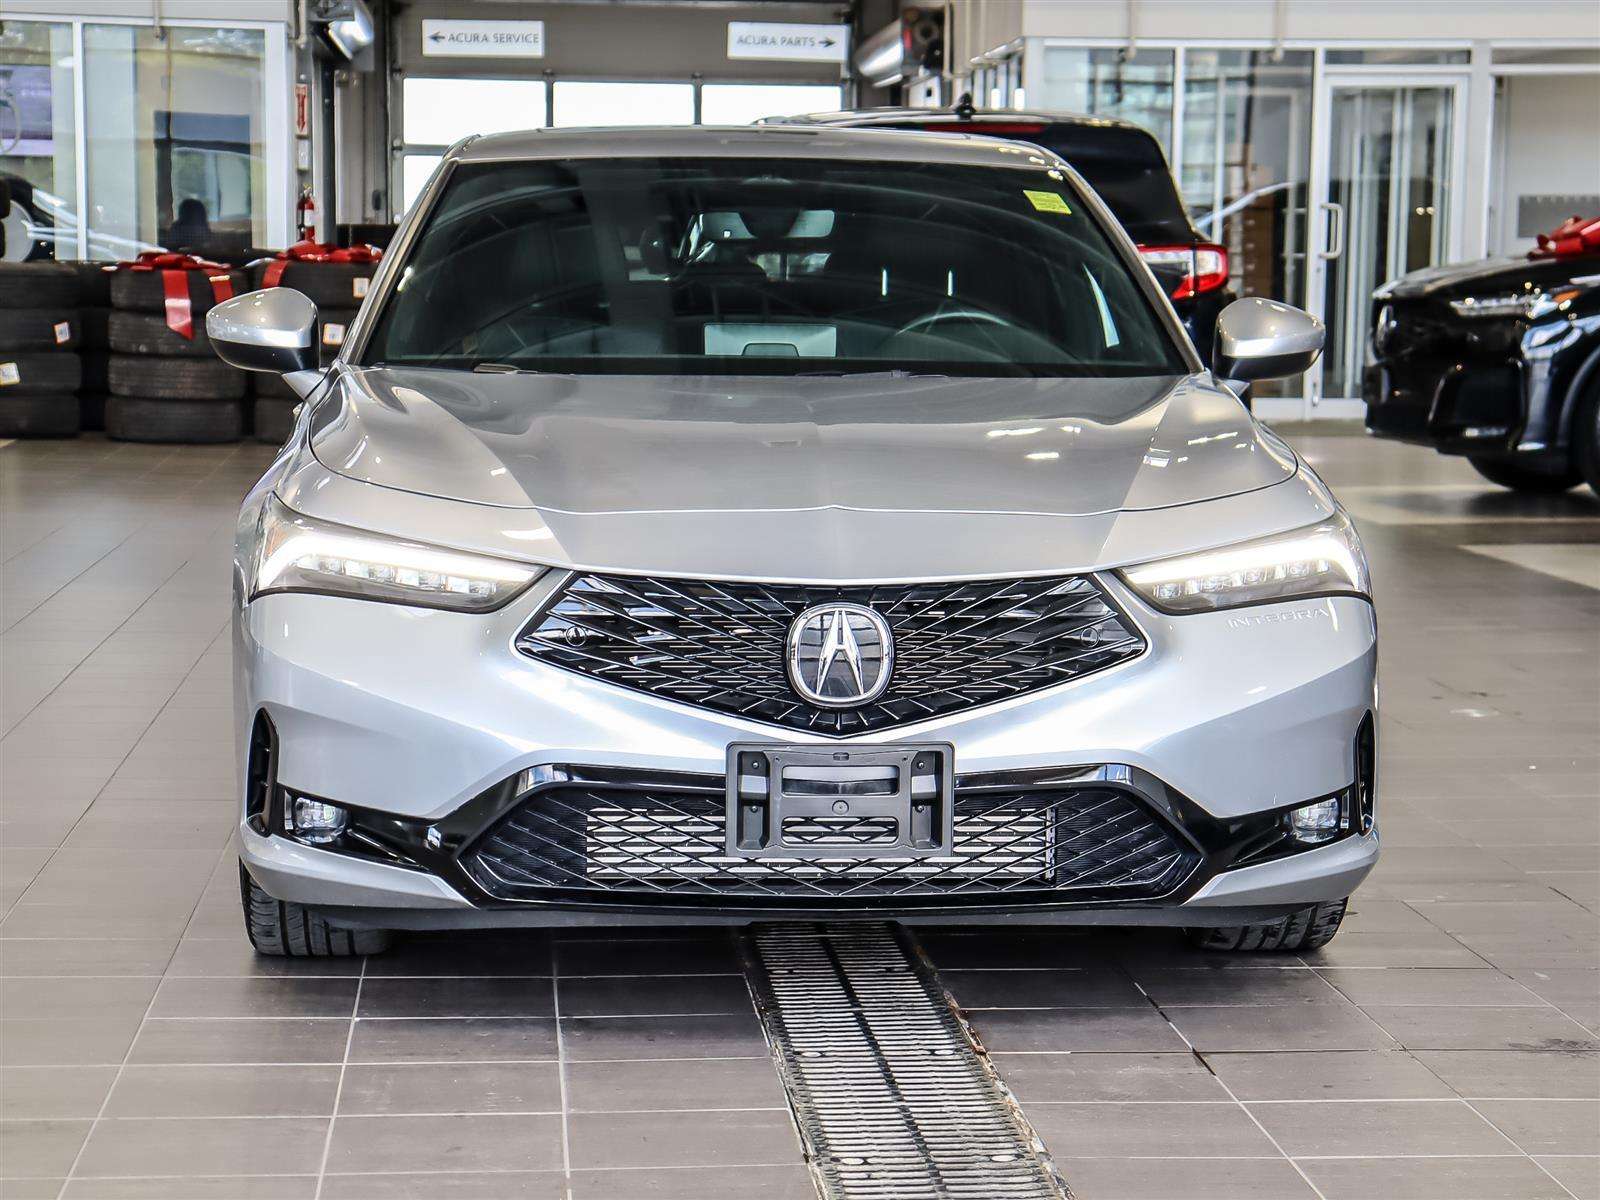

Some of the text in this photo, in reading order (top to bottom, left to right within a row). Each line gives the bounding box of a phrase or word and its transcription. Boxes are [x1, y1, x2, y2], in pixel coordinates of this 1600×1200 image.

[448, 33, 540, 44] ACURA SERVICE
[737, 35, 816, 47] ACURA PARTS
[1226, 608, 1329, 629] INTEGRA
